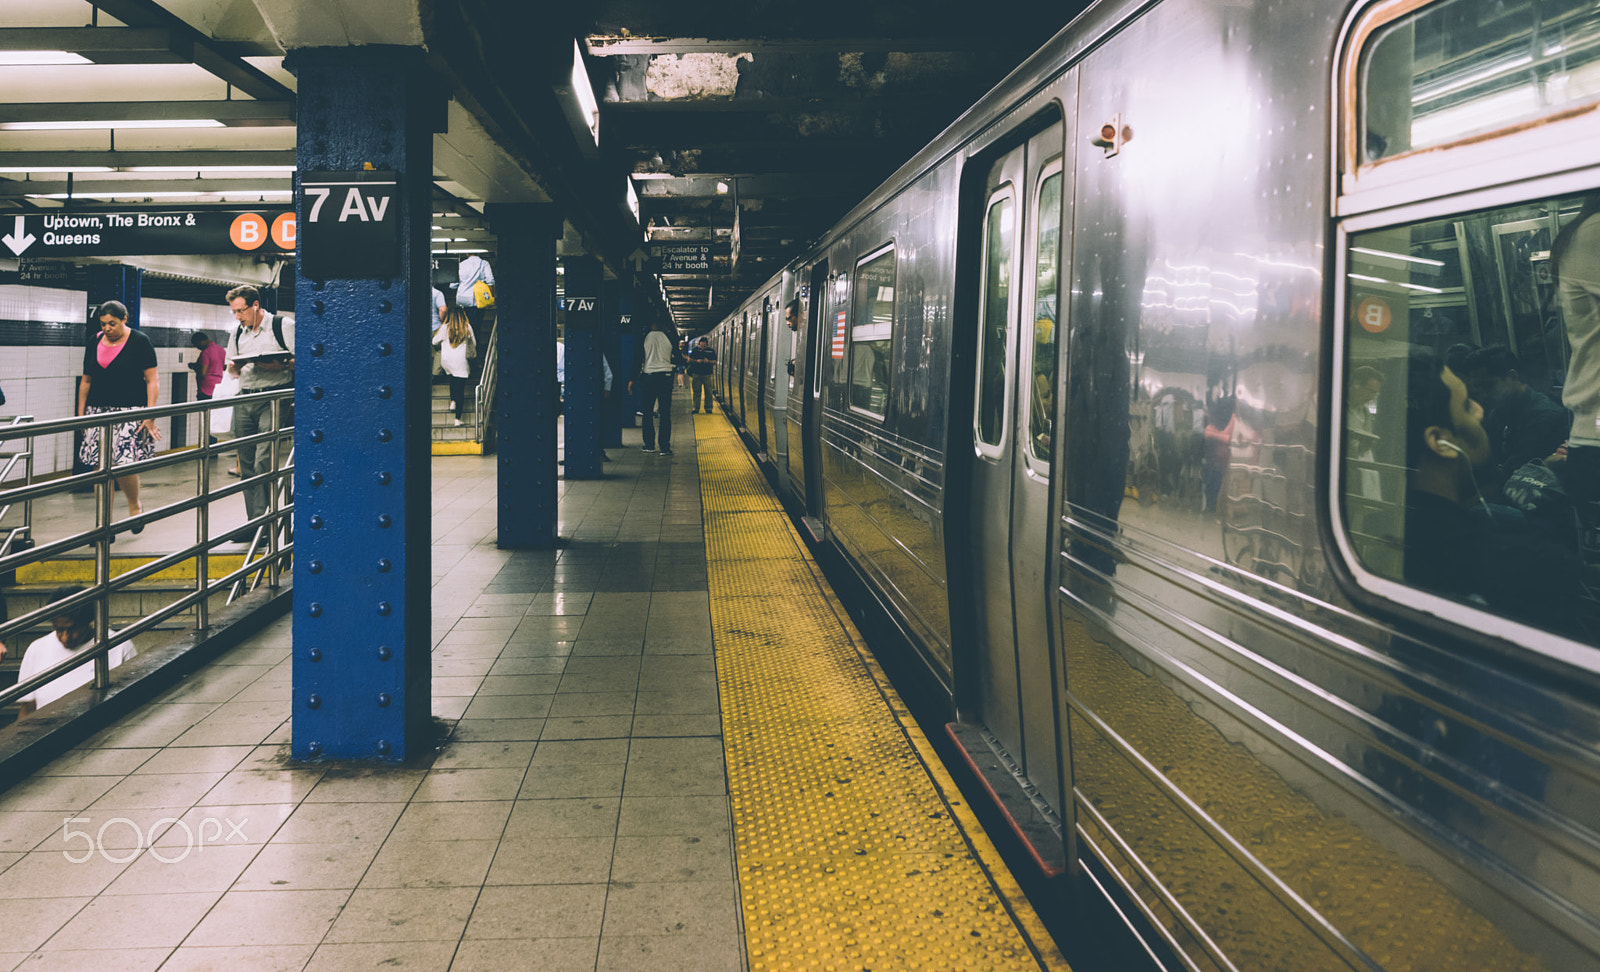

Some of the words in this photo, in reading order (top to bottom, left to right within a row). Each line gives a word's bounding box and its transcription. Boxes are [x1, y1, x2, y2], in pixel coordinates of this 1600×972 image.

[304, 188, 330, 222] 7
[338, 187, 390, 222] Av
[43, 215, 103, 230] Uptown,
[106, 214, 133, 227] The
[137, 213, 181, 227] Bronx
[185, 213, 196, 226] &
[240, 220, 259, 242] B
[281, 220, 296, 242] D
[43, 231, 101, 245] Queens
[20, 272, 31, 280] 24
[566, 299, 575, 311] 7
[577, 299, 594, 311] Av
[88, 306, 98, 318] 7
[620, 315, 631, 324] Av
